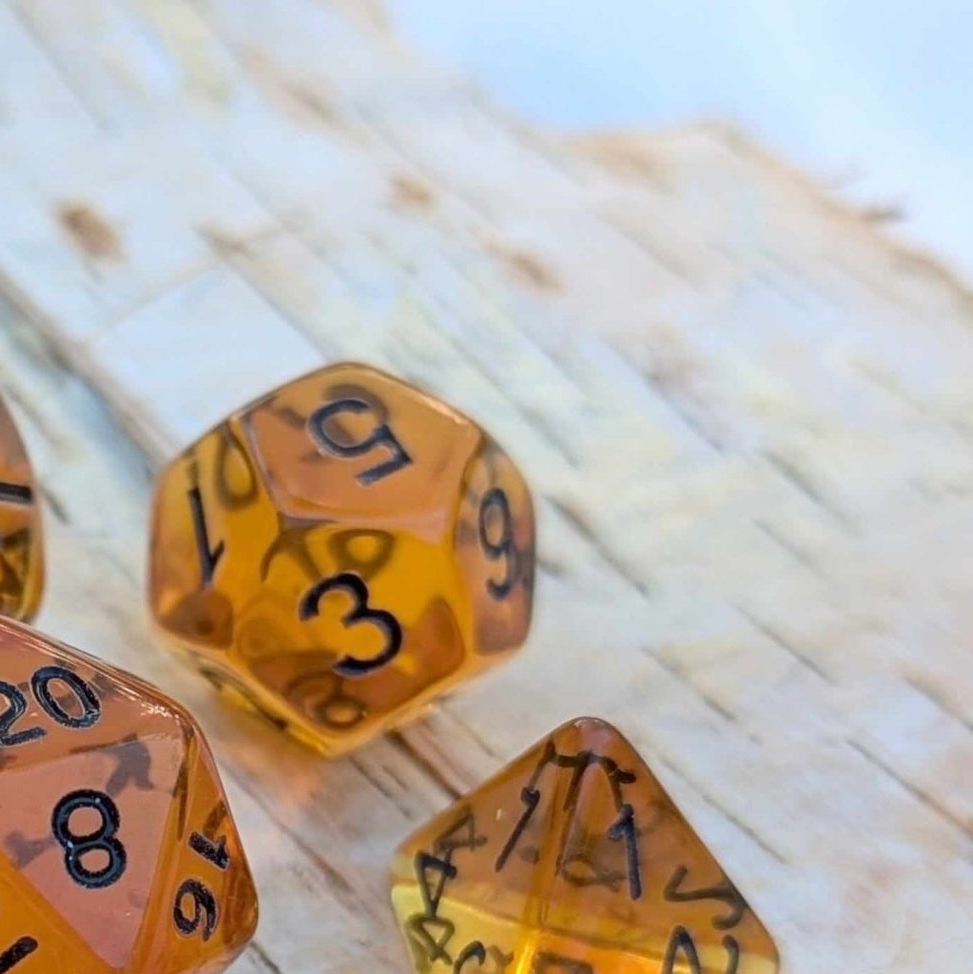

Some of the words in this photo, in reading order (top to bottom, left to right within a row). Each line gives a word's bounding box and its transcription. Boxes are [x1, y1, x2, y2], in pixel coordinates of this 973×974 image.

[307, 397, 412, 486] 5
[187, 484, 226, 586] 1
[299, 573, 403, 676] 3
[51, 789, 127, 889] 8
